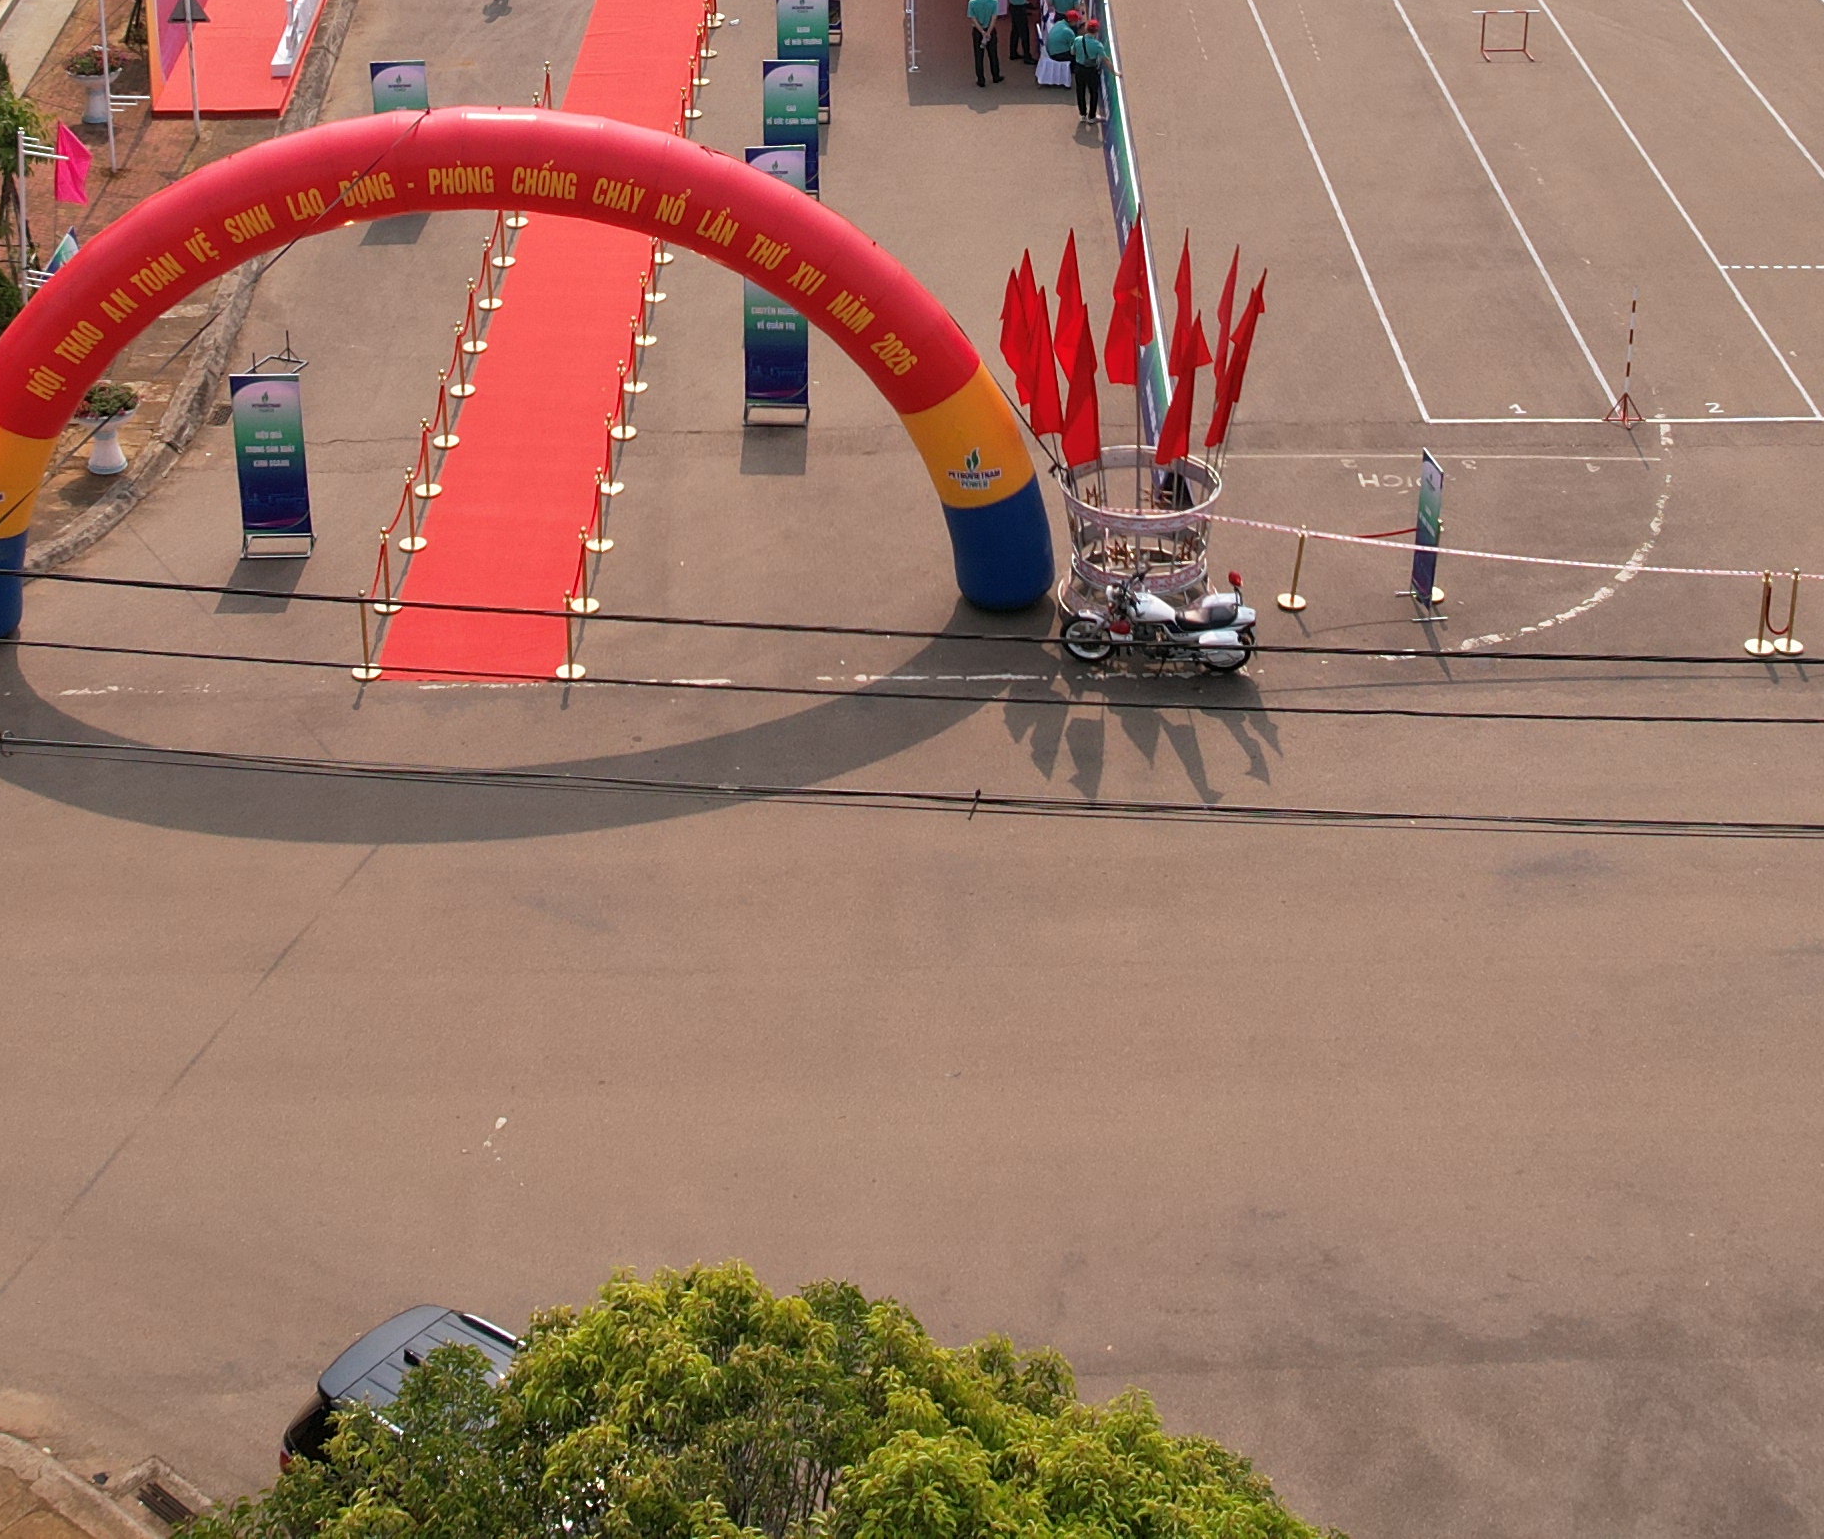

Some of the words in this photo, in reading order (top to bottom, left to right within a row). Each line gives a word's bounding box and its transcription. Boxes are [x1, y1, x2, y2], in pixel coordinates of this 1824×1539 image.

[26, 365, 66, 401] HỘI
[100, 287, 138, 323] AN
[130, 252, 186, 297] TOÀN
[184, 227, 220, 262] VỆ
[224, 204, 275, 244] SINH
[286, 188, 326, 222] LAO
[339, 171, 395, 209] ĐỘNG
[512, 160, 577, 199] CHỐNG
[592, 179, 646, 213] CHÁY
[655, 189, 691, 225] NỔ
[746, 233, 791, 270] THỨ
[787, 261, 826, 296] XVI
[826, 290, 875, 334] NĂM
[870, 332, 917, 376] 2026
[1509, 403, 1527, 414] 1
[1705, 402, 1724, 413] 2
